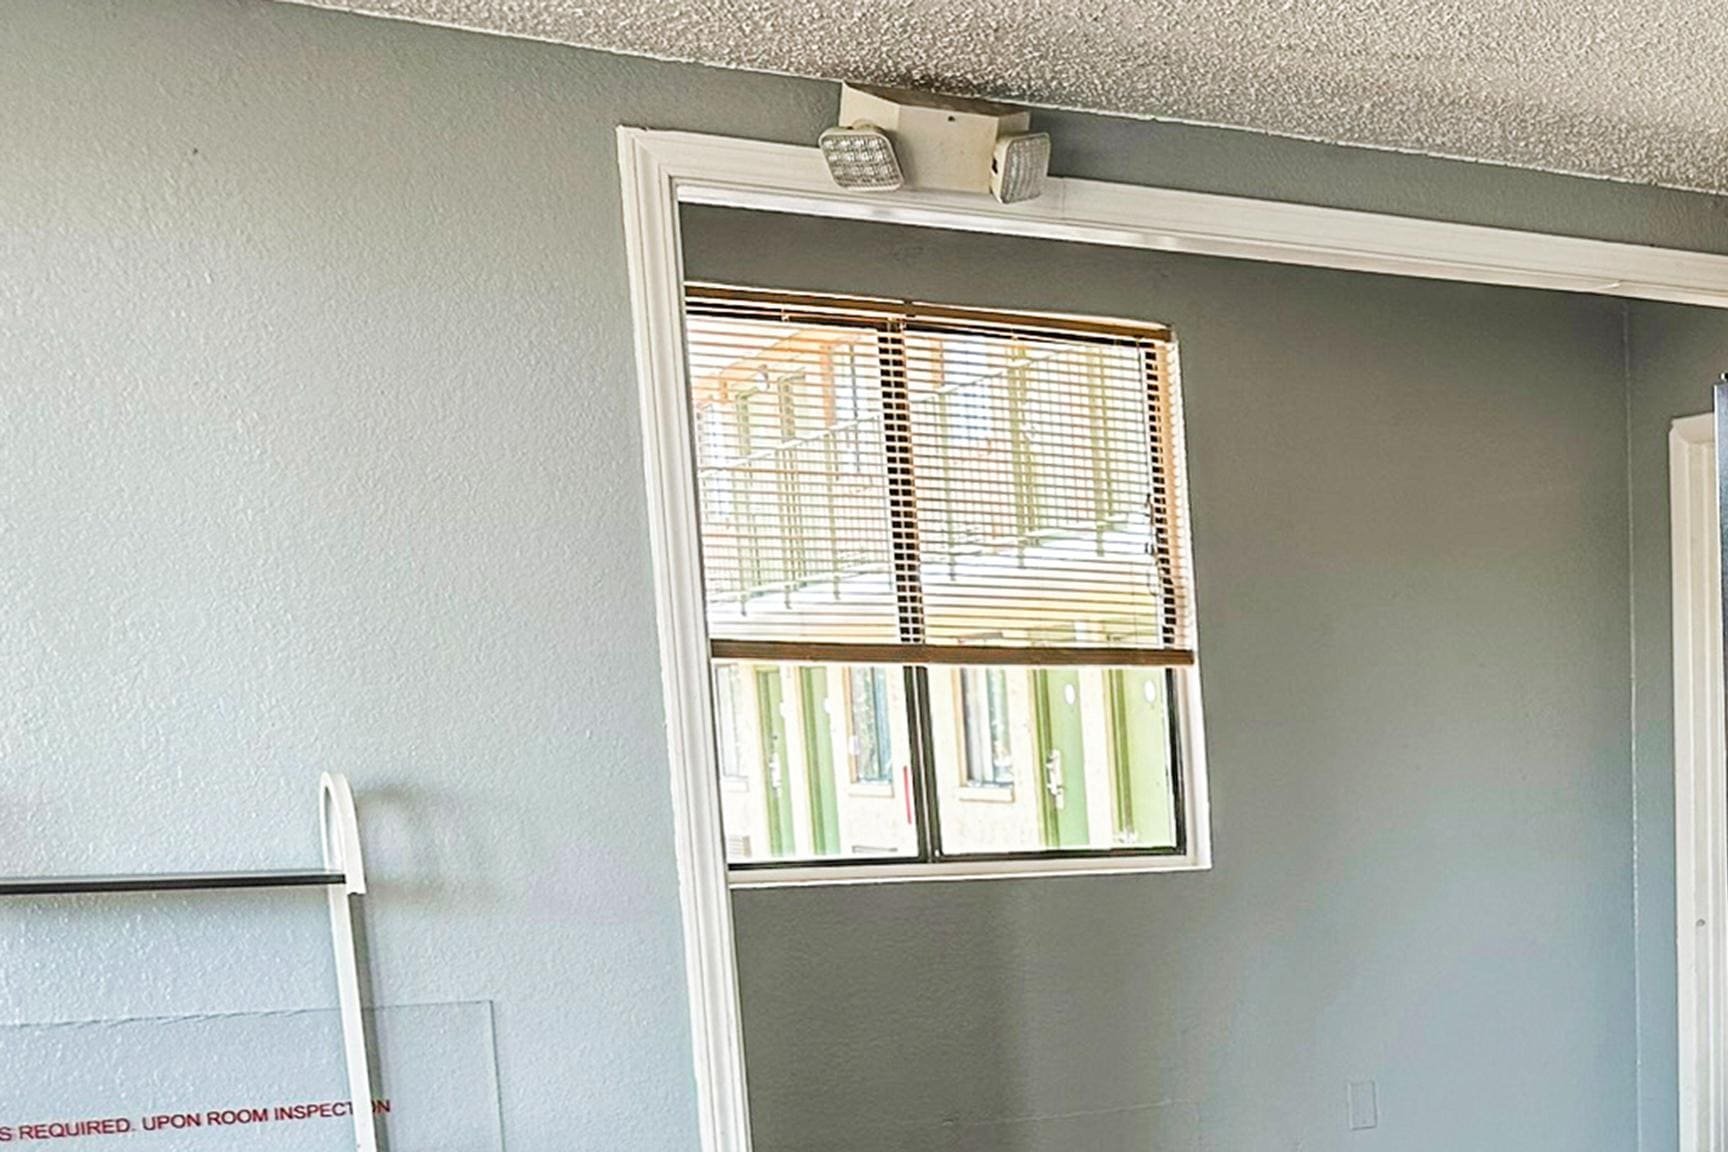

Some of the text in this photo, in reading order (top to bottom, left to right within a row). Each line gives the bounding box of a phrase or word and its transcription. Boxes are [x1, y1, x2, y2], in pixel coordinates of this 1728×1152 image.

[19, 1118, 136, 1139] REQUIRED.
[142, 1113, 201, 1131] UPON
[207, 1107, 268, 1126] ROOM
